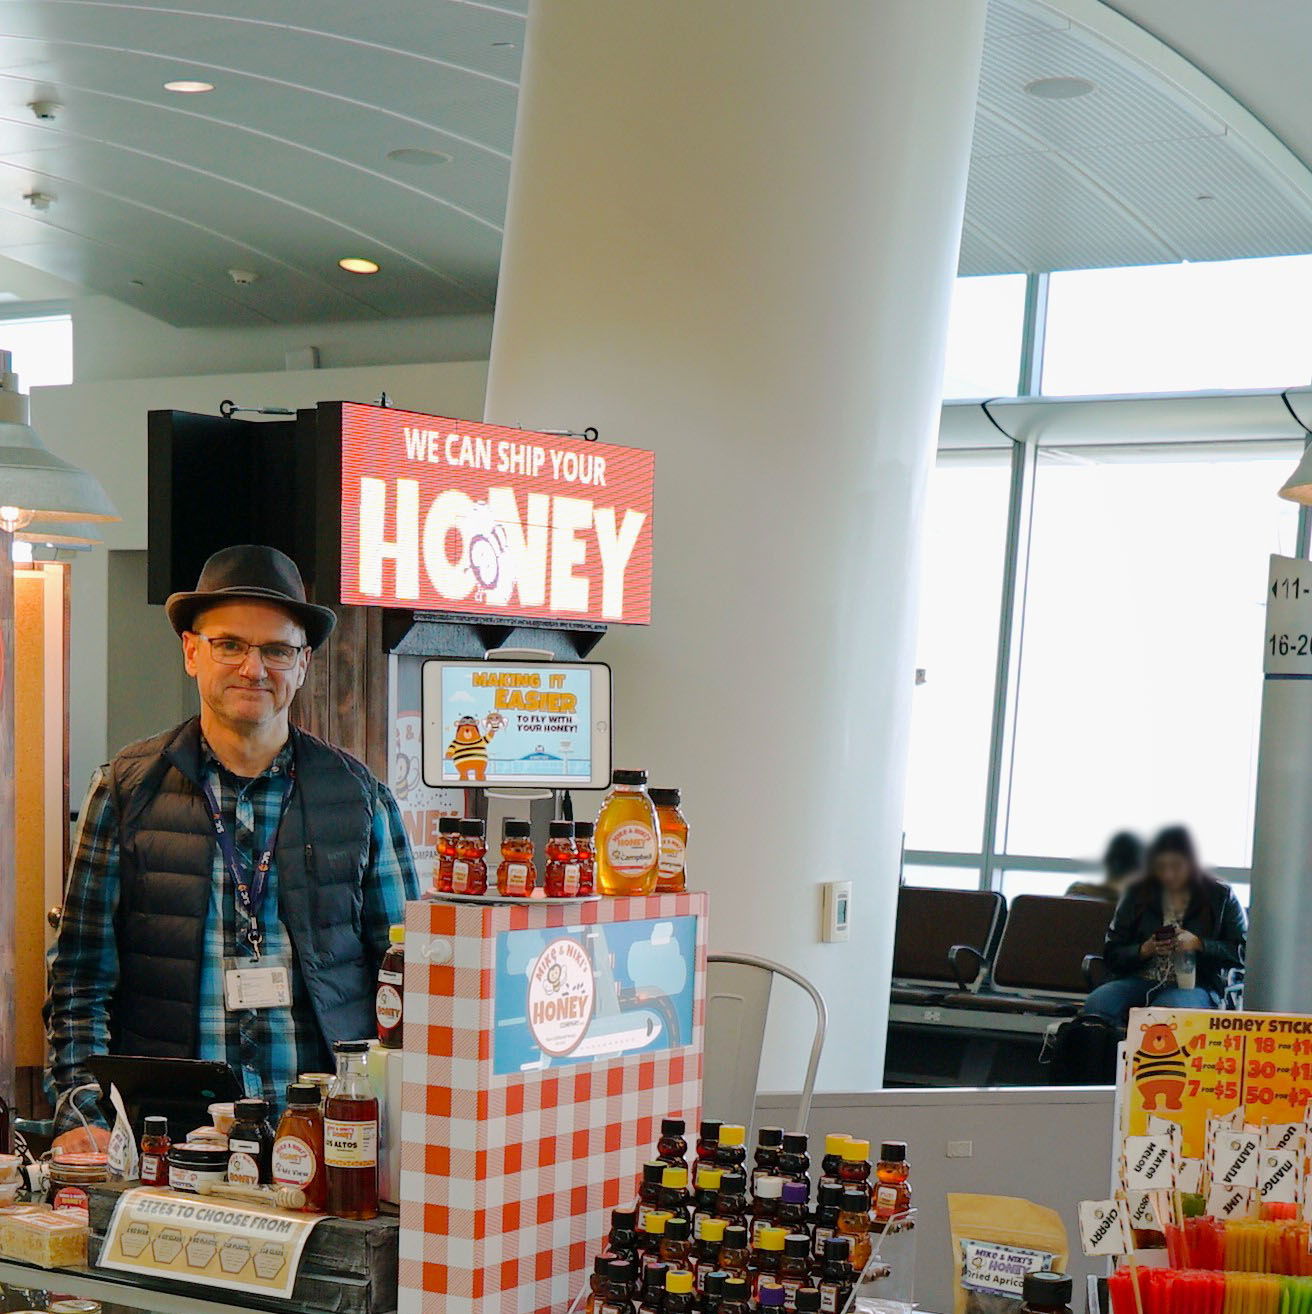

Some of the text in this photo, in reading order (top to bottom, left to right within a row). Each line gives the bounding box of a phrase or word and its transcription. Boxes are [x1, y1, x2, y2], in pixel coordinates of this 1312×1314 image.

[403, 427, 606, 487] WE CAN SHIP YOUR
[358, 476, 648, 620] HONEY
[472, 671, 566, 689] MAKING IT
[494, 688, 577, 714] EASIER
[517, 715, 572, 724] TO FLY WITH
[517, 724, 542, 732] YOUR
[533, 994, 588, 1025] HONEY
[1223, 1034, 1241, 1052] $1
[1254, 1037, 1276, 1053] 18
[1191, 1056, 1203, 1072] 4
[1215, 1056, 1237, 1074] $3
[1247, 1060, 1276, 1079] 30
[1188, 1080, 1201, 1097] 7
[1215, 1080, 1237, 1100] $5
[1246, 1086, 1275, 1105] 50
[137, 1199, 292, 1234] SIZES TO CHOOSE FROM
[992, 1275, 1024, 1288] Aprico
